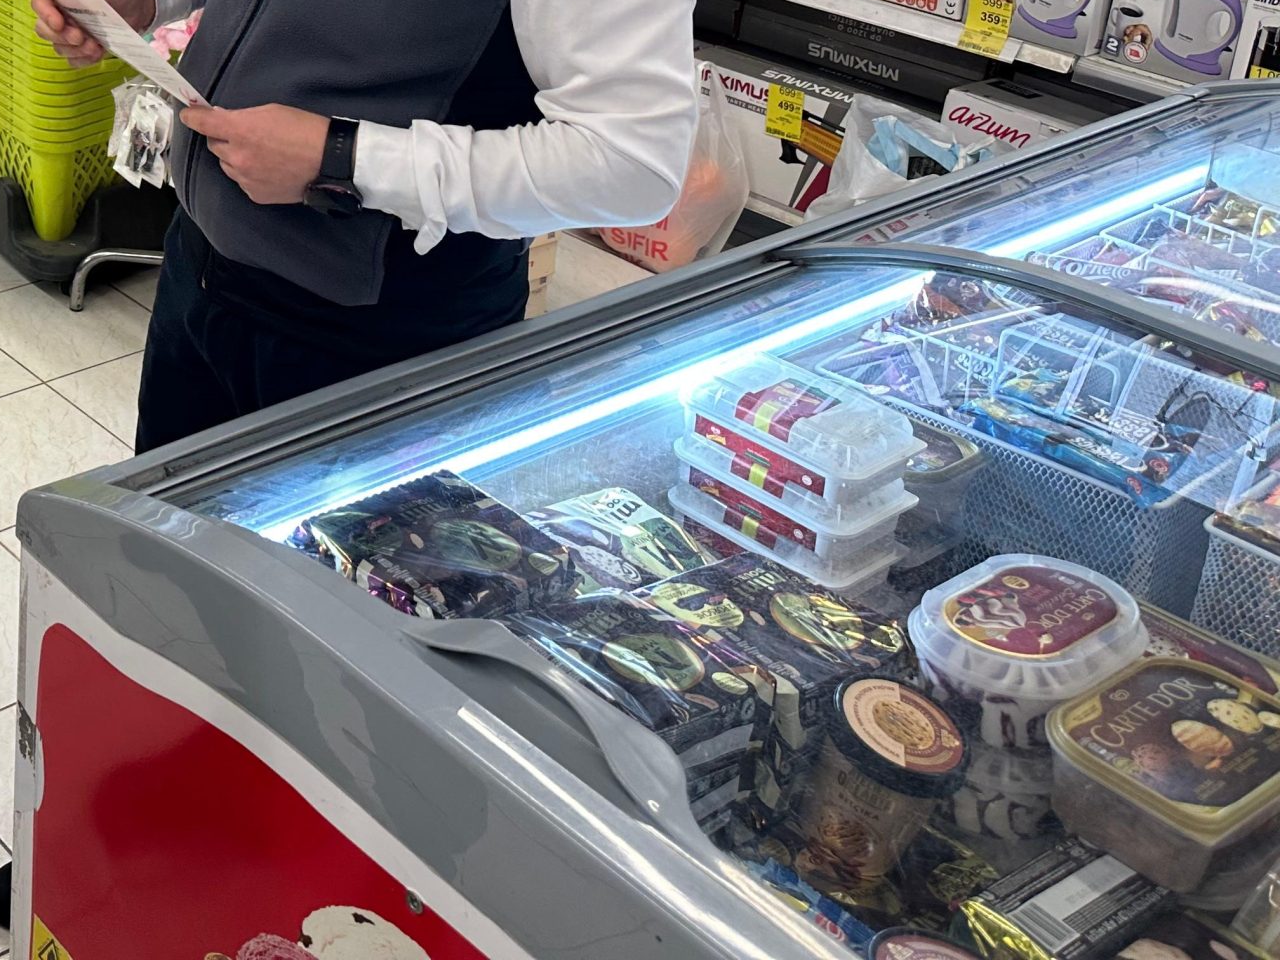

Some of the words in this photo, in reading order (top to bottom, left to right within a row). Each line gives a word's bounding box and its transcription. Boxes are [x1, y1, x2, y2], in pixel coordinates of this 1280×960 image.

[981, 12, 1000, 25] 359
[1107, 38, 1119, 51] 2
[808, 42, 900, 82] MAXIMUS
[762, 69, 855, 104] MAXIMUS
[779, 87, 796, 97] 699
[777, 100, 795, 112] 499
[948, 106, 1031, 149] arzum
[611, 227, 669, 262] SIFIR
[1065, 588, 1107, 613] CARTE
[1090, 702, 1156, 748] CARTE
[1156, 676, 1214, 709] D'OR
